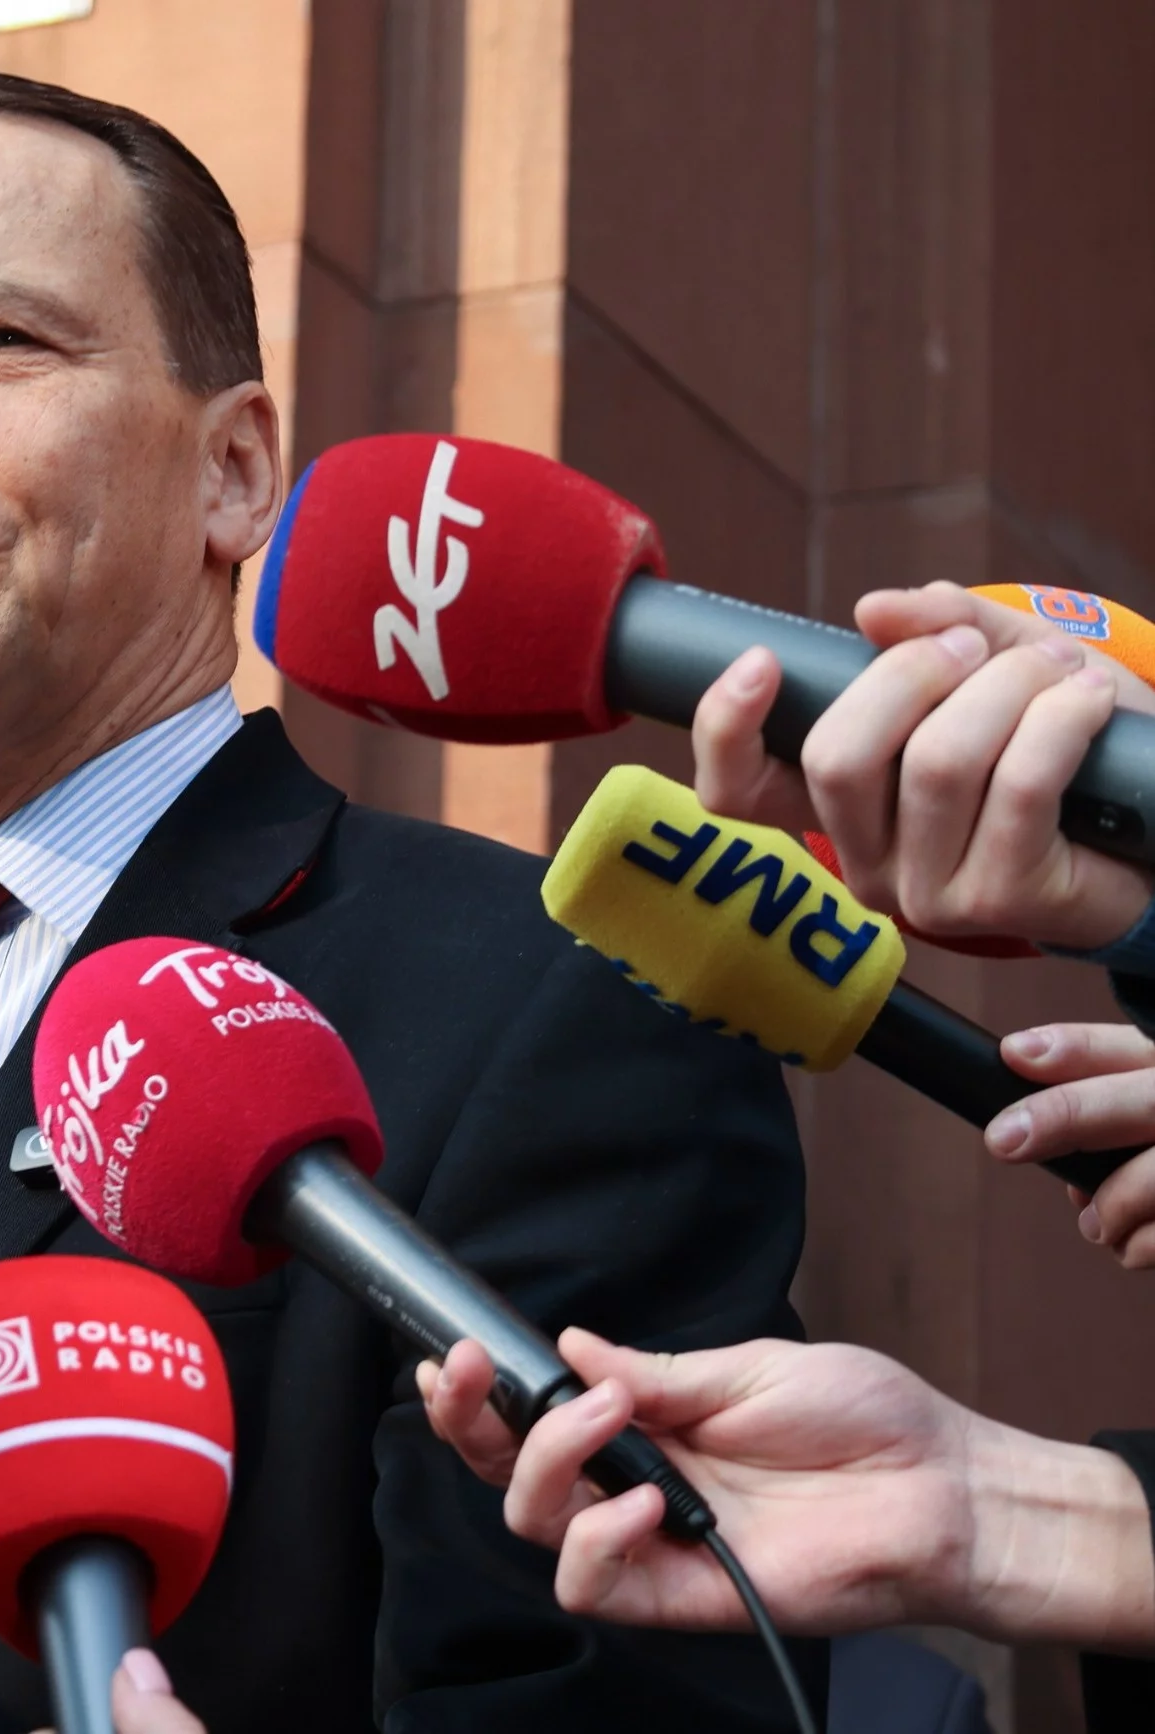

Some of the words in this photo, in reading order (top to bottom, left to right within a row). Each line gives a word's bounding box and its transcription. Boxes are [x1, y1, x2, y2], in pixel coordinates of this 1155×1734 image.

[622, 820, 880, 988] RMF
[211, 1000, 307, 1037] POLSKIE
[113, 1074, 169, 1160] RADIO
[52, 1320, 204, 1364] POLSKIE
[57, 1346, 207, 1391] RADIO
